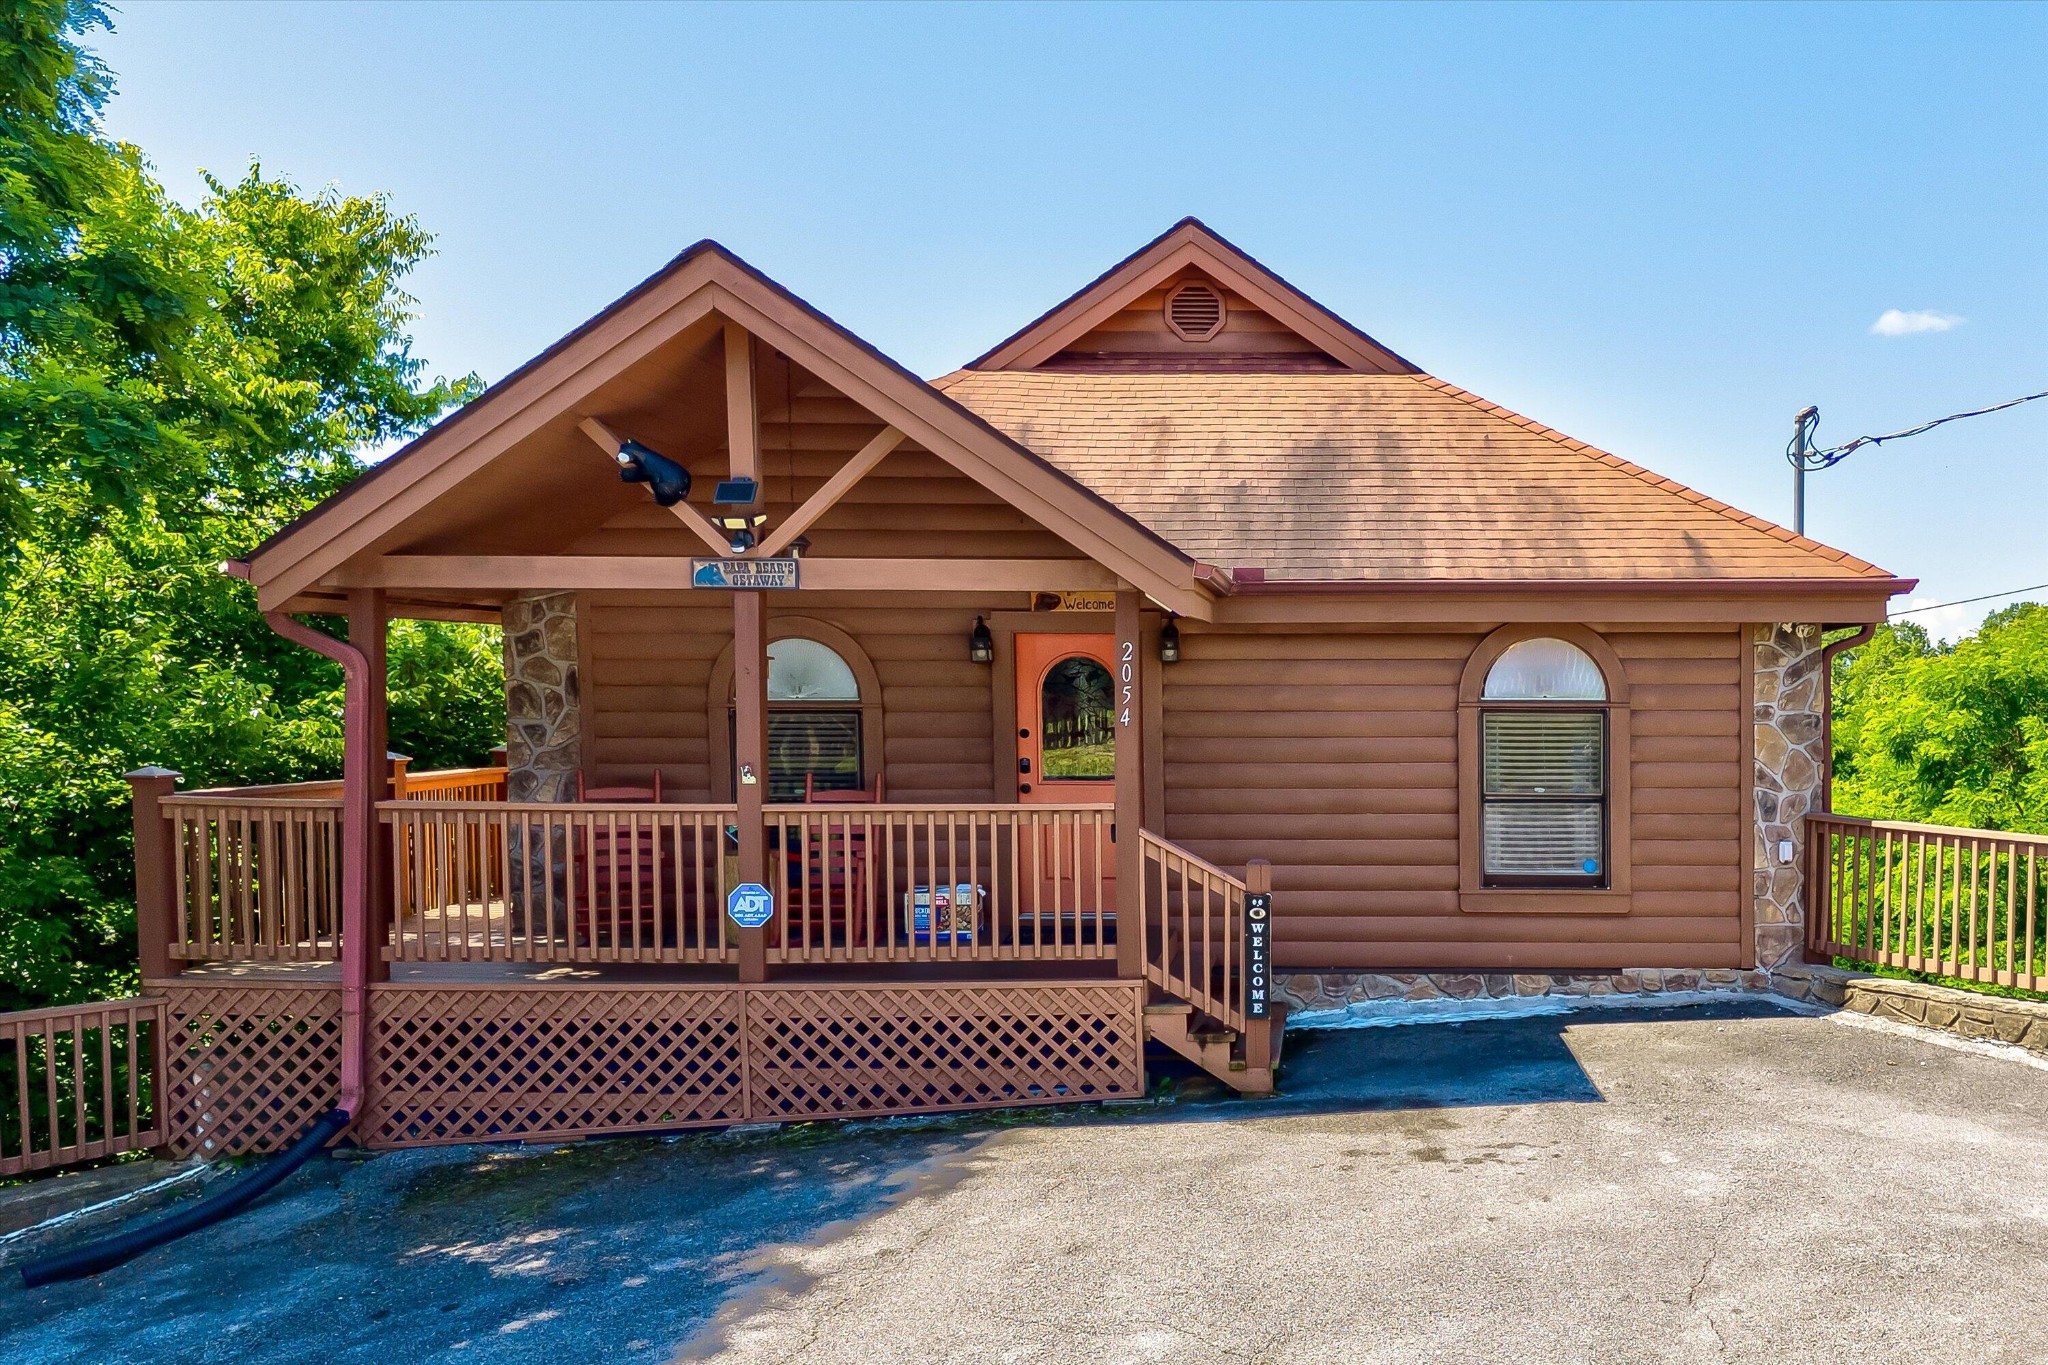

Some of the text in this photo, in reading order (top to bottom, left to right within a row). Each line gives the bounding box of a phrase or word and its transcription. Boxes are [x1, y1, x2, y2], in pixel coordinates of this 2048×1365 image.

[722, 562, 794, 574] PAPA BEAR'S
[732, 575, 785, 586] GETAWAY
[1063, 597, 1115, 610] Welcome
[1120, 642, 1133, 727] 2054
[733, 896, 769, 913] ADT
[1251, 923, 1265, 1014] WELCOME
